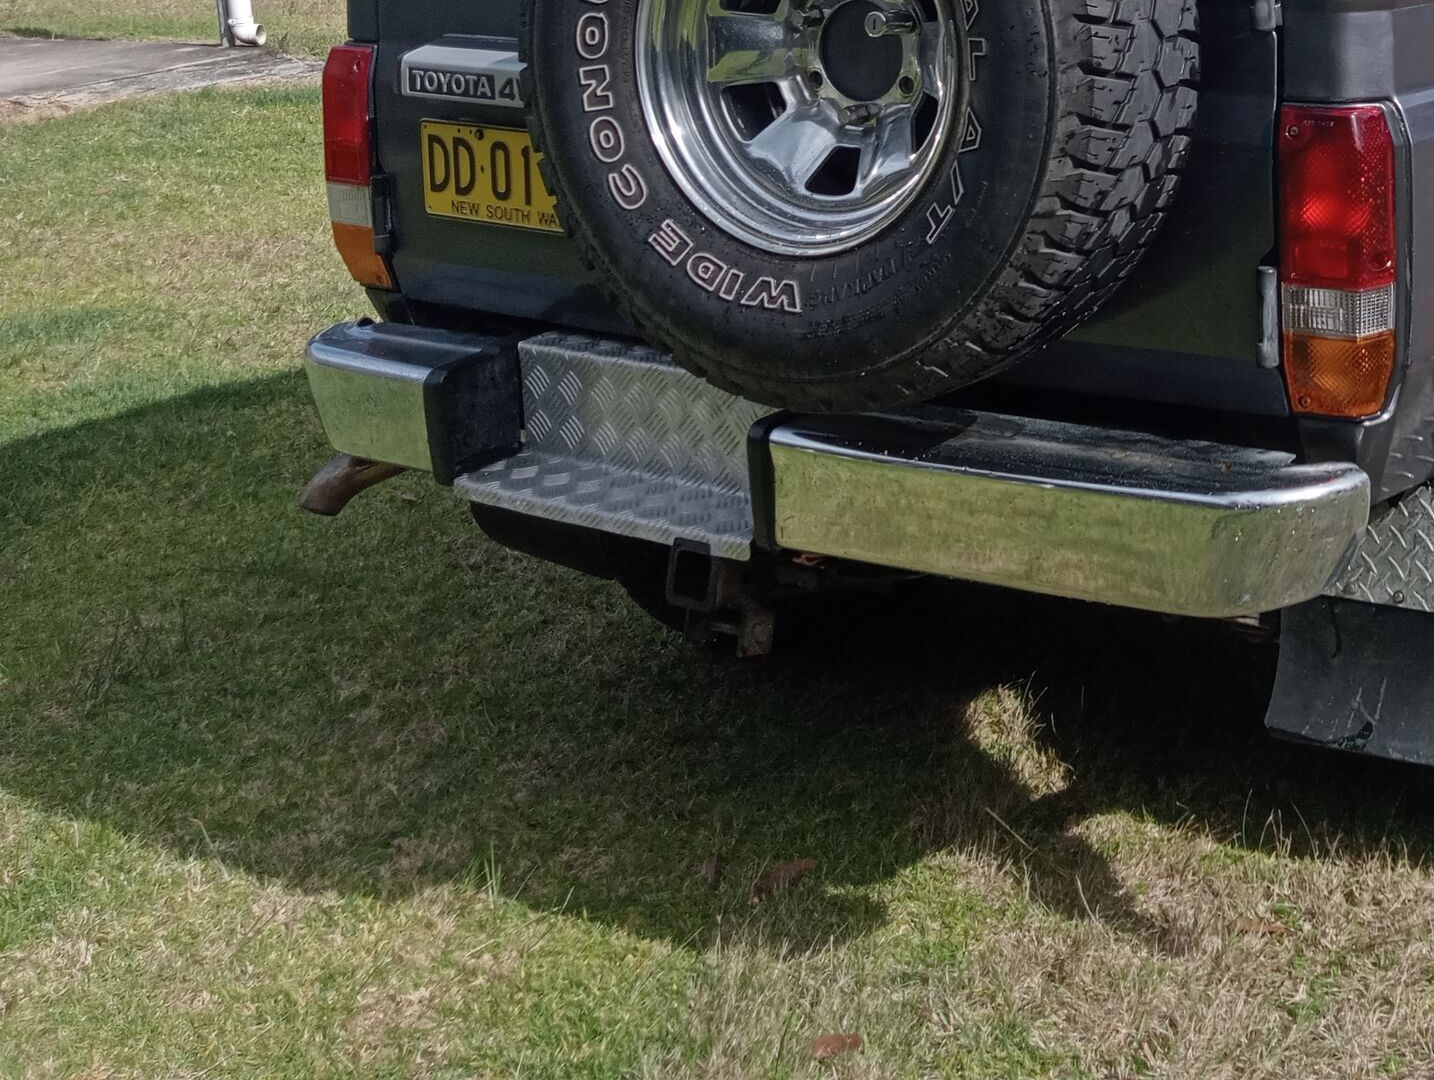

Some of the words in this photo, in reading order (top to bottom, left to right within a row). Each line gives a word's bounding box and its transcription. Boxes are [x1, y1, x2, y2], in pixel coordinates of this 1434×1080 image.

[411, 69, 492, 97] TOYOTA
[924, 106, 982, 246] A/T
[451, 199, 481, 217] NEW
[486, 204, 531, 224] SOUTH
[537, 210, 558, 228] WA
[648, 219, 802, 313] WIDE
